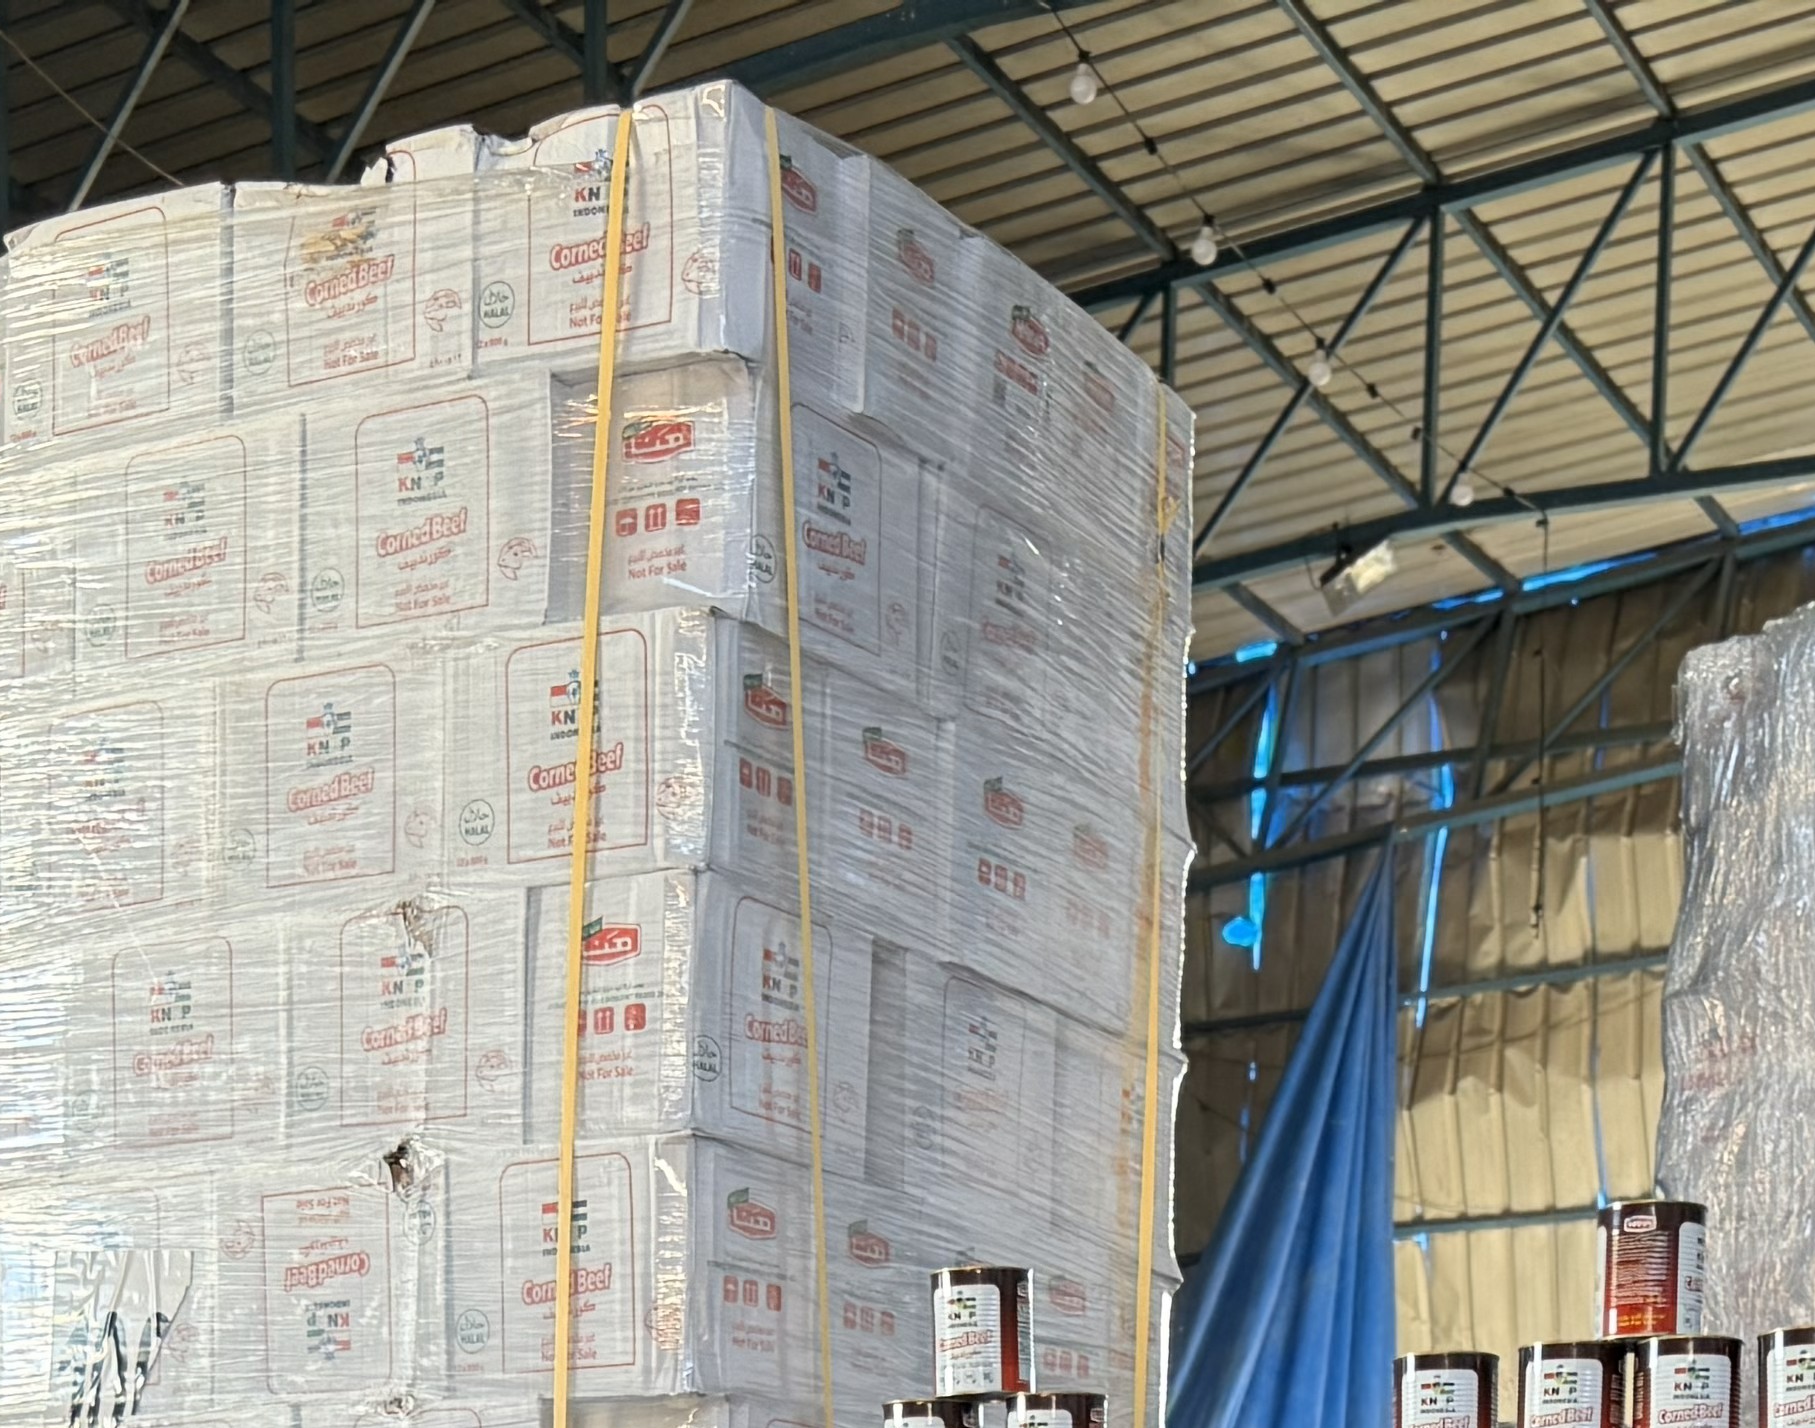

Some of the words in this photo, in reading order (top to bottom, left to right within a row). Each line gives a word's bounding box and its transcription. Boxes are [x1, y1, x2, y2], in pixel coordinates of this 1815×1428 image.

[304, 262, 356, 307] Corned
[354, 255, 394, 292] Beef
[397, 470, 446, 492] KNP
[376, 515, 432, 558] Corned
[431, 506, 468, 543] Beef
[628, 564, 647, 581] Not
[648, 563, 663, 578] For
[306, 736, 352, 757] KNP
[287, 778, 340, 812] Corned
[338, 767, 376, 801] Beef
[381, 978, 425, 996] KNP
[1543, 1386, 1578, 1398] KNP
[1673, 1381, 1710, 1392] KNP
[1420, 1396, 1455, 1407] KNP
